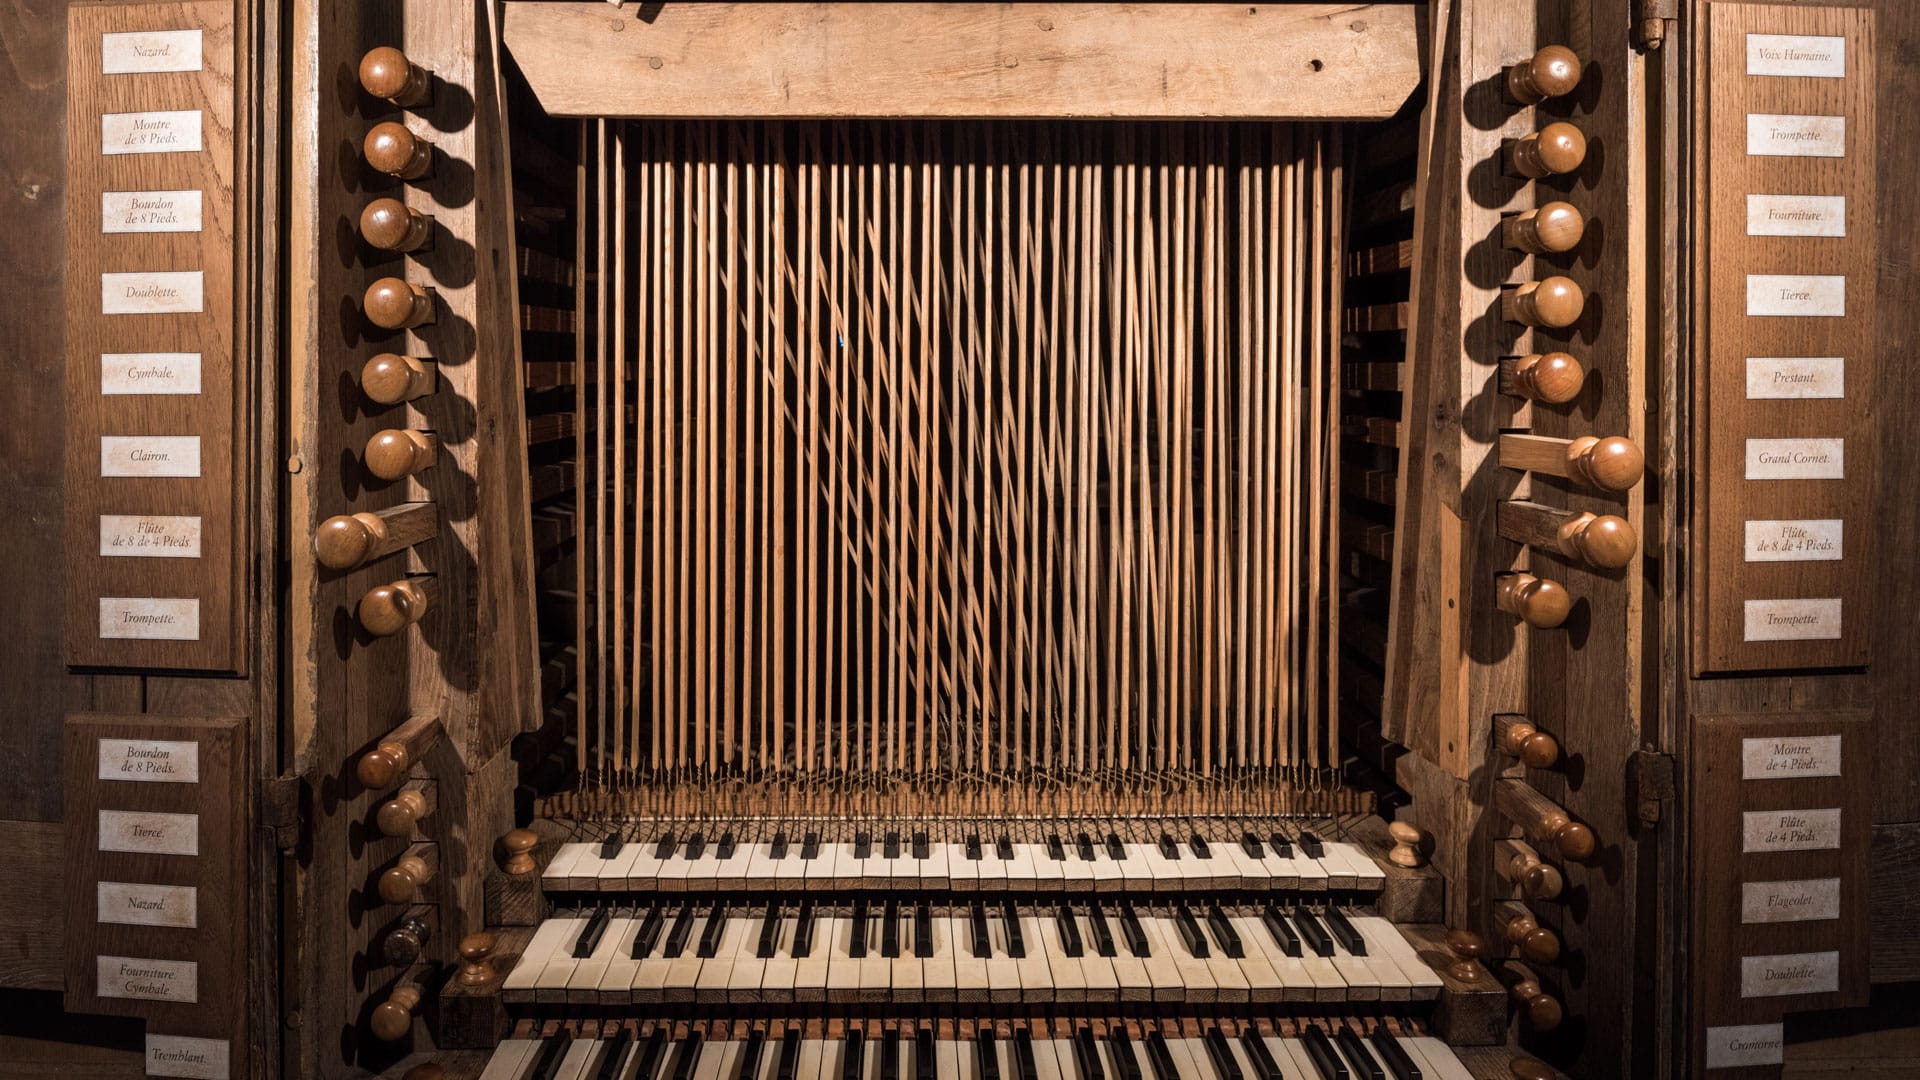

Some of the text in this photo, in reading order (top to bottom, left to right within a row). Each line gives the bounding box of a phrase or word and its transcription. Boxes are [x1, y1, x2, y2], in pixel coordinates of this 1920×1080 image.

[133, 45, 171, 58] Nazard.
[1759, 48, 1833, 62] Voix Humaine.
[133, 119, 171, 131] Montre
[125, 133, 178, 145] de 8 Pieds.
[1770, 128, 1822, 143] Trompette.
[131, 198, 174, 210] Bourdon
[125, 212, 178, 224] de 8 Pieds.
[1769, 209, 1824, 222] Fourniture.
[126, 286, 179, 298] Doublette.
[1780, 288, 1811, 301] Tierce.
[128, 367, 174, 381] Cymbale.
[1773, 371, 1817, 384] Prestant.
[130, 449, 170, 462] Clairon.
[1759, 452, 1831, 464] Grand Cornet.
[137, 521, 165, 534] Flûte
[1782, 526, 1808, 539] Flûte
[112, 536, 192, 548] de 8 de 4 Pieds.
[1757, 539, 1834, 552] de 8 de 4 Pieds.
[123, 611, 176, 626] Trompette.
[1767, 613, 1819, 626] Trompette.
[127, 746, 170, 759] Bourdon
[1774, 743, 1811, 756] Montre
[121, 761, 175, 774] de 8 Pieds.
[1766, 758, 1819, 771] de 4 Pieds.
[1780, 816, 1806, 829] Flûte
[132, 825, 164, 838] Tierce.
[1765, 831, 1818, 844] de 4 Pieds.
[128, 897, 165, 911] Nazard.
[1768, 894, 1814, 908] Flageolet.
[152, 1048, 207, 1064] Tremblant.
